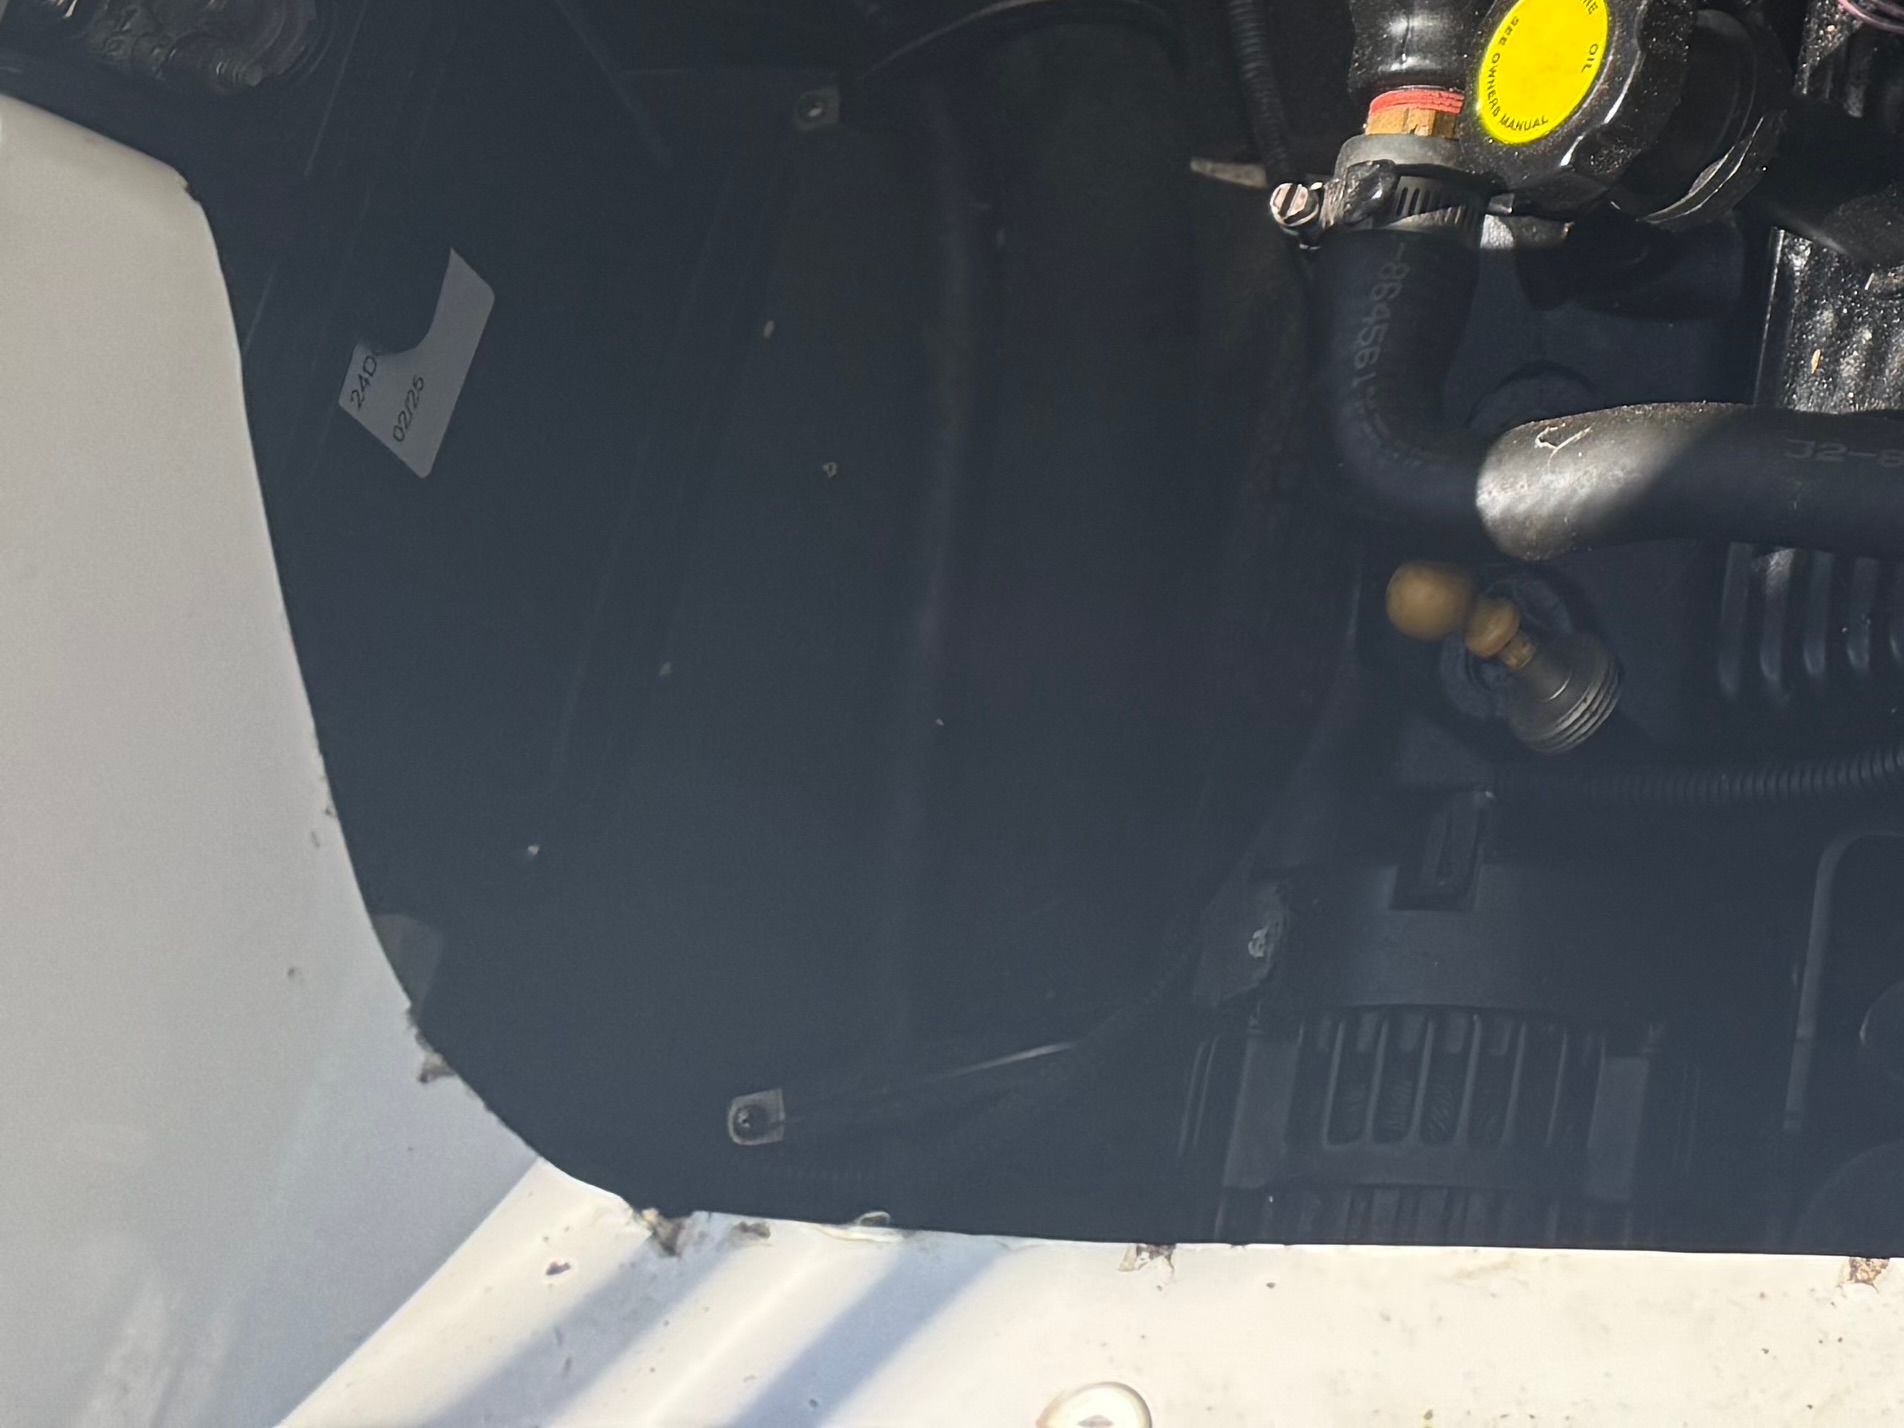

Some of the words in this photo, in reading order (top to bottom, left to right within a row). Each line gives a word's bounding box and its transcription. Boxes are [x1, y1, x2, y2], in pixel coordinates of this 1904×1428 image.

[1499, 16, 1519, 46] SEE
[1581, 43, 1599, 73] OIL
[1499, 114, 1549, 132] MANUAL
